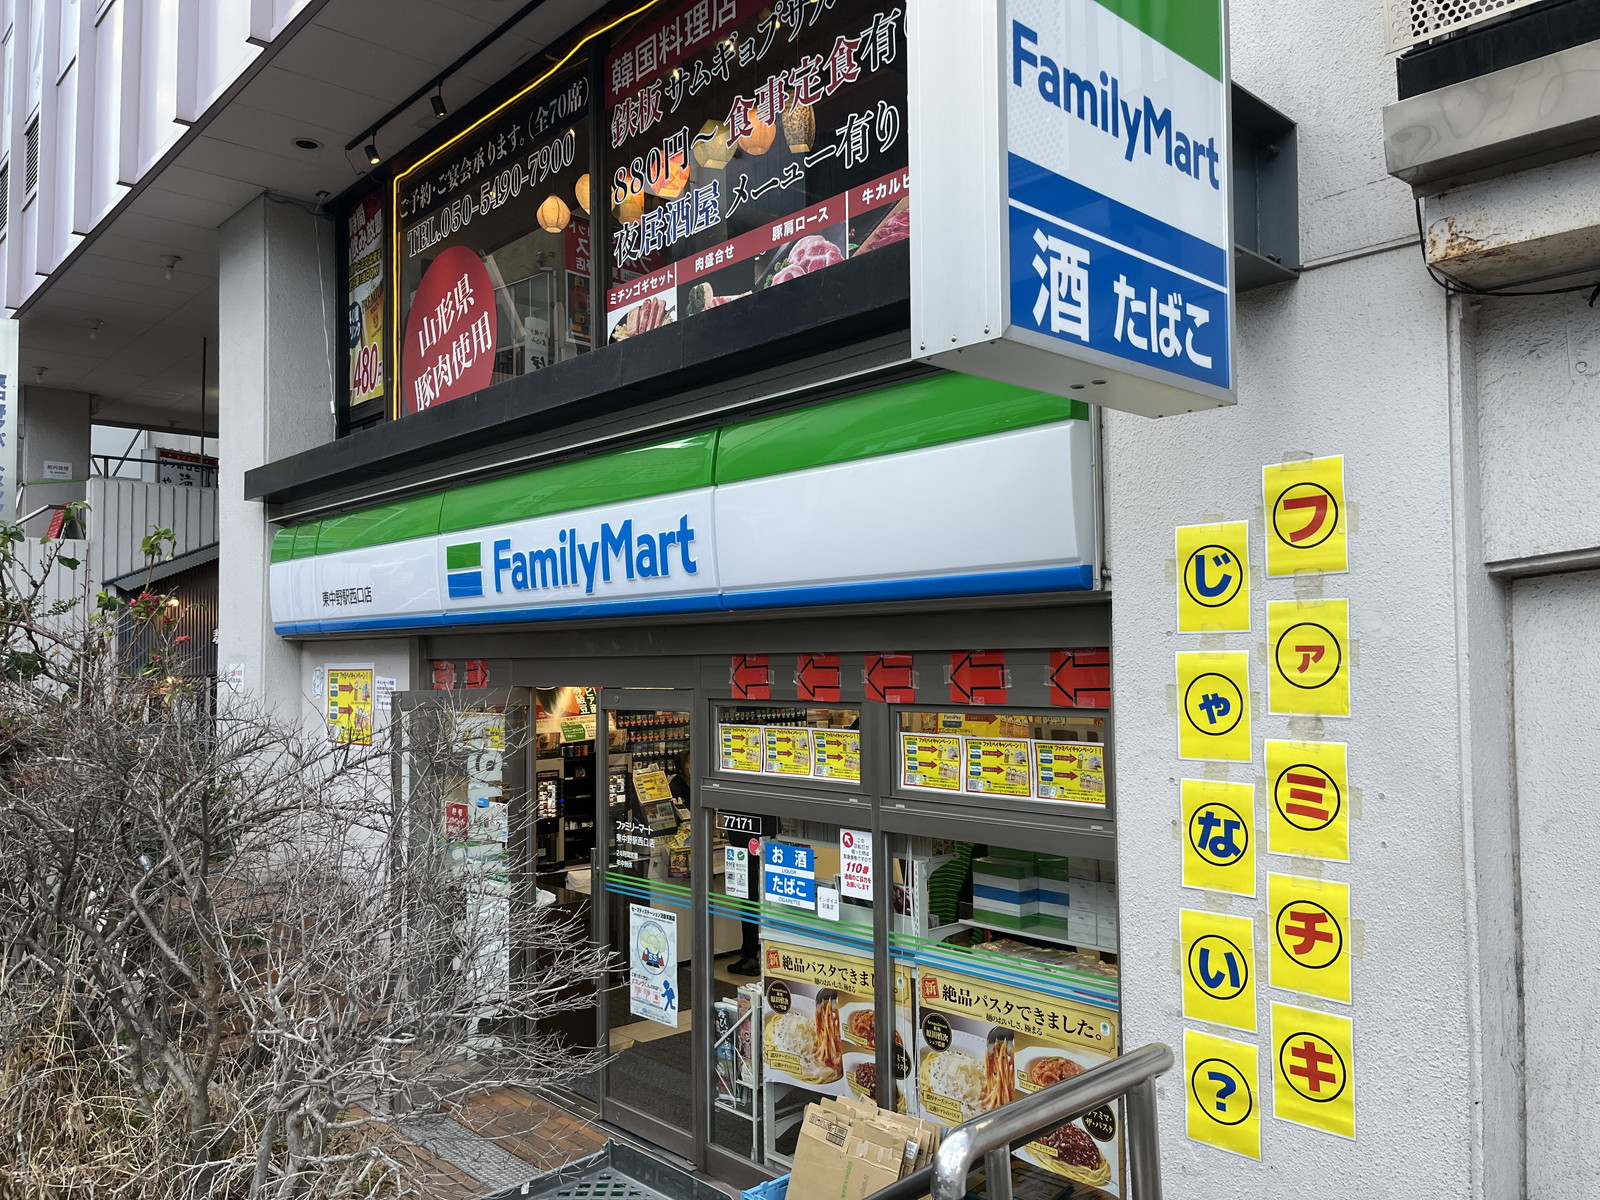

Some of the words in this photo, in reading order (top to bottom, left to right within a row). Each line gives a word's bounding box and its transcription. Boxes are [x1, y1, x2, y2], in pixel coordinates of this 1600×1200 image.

[611, 0, 736, 95] 韓国料理店
[614, 8, 908, 204] 880円〜食事定食有
[1012, 19, 1219, 190] FamilyMart
[407, 131, 575, 257] TEL.050-5490-7900
[772, 206, 829, 242] 豚肩ロース
[695, 244, 735, 273] 肉盛合せ
[610, 270, 674, 306] ミチンゴギセット
[1032, 228, 1090, 342] 酒
[1113, 274, 1212, 369] たばこ
[418, 273, 475, 358] 山形県
[413, 311, 493, 412] 豚肉使用
[493, 514, 698, 594] FamilyMart
[322, 586, 372, 607] 東中野駅西口店
[616, 820, 654, 835] ファミリーマート
[724, 815, 752, 830] 77171
[616, 833, 656, 849] 東中野駅西口店
[772, 846, 807, 869] お酒
[846, 862, 869, 875] 110番
[772, 876, 807, 898] たばこ
[778, 897, 800, 906] CIGARETTE
[942, 984, 1101, 1041] 絶品パスタできました。
[986, 1013, 1043, 1036] 麺のおいしさ、極まる
[1085, 1117, 1114, 1134] ザ・パスタ
